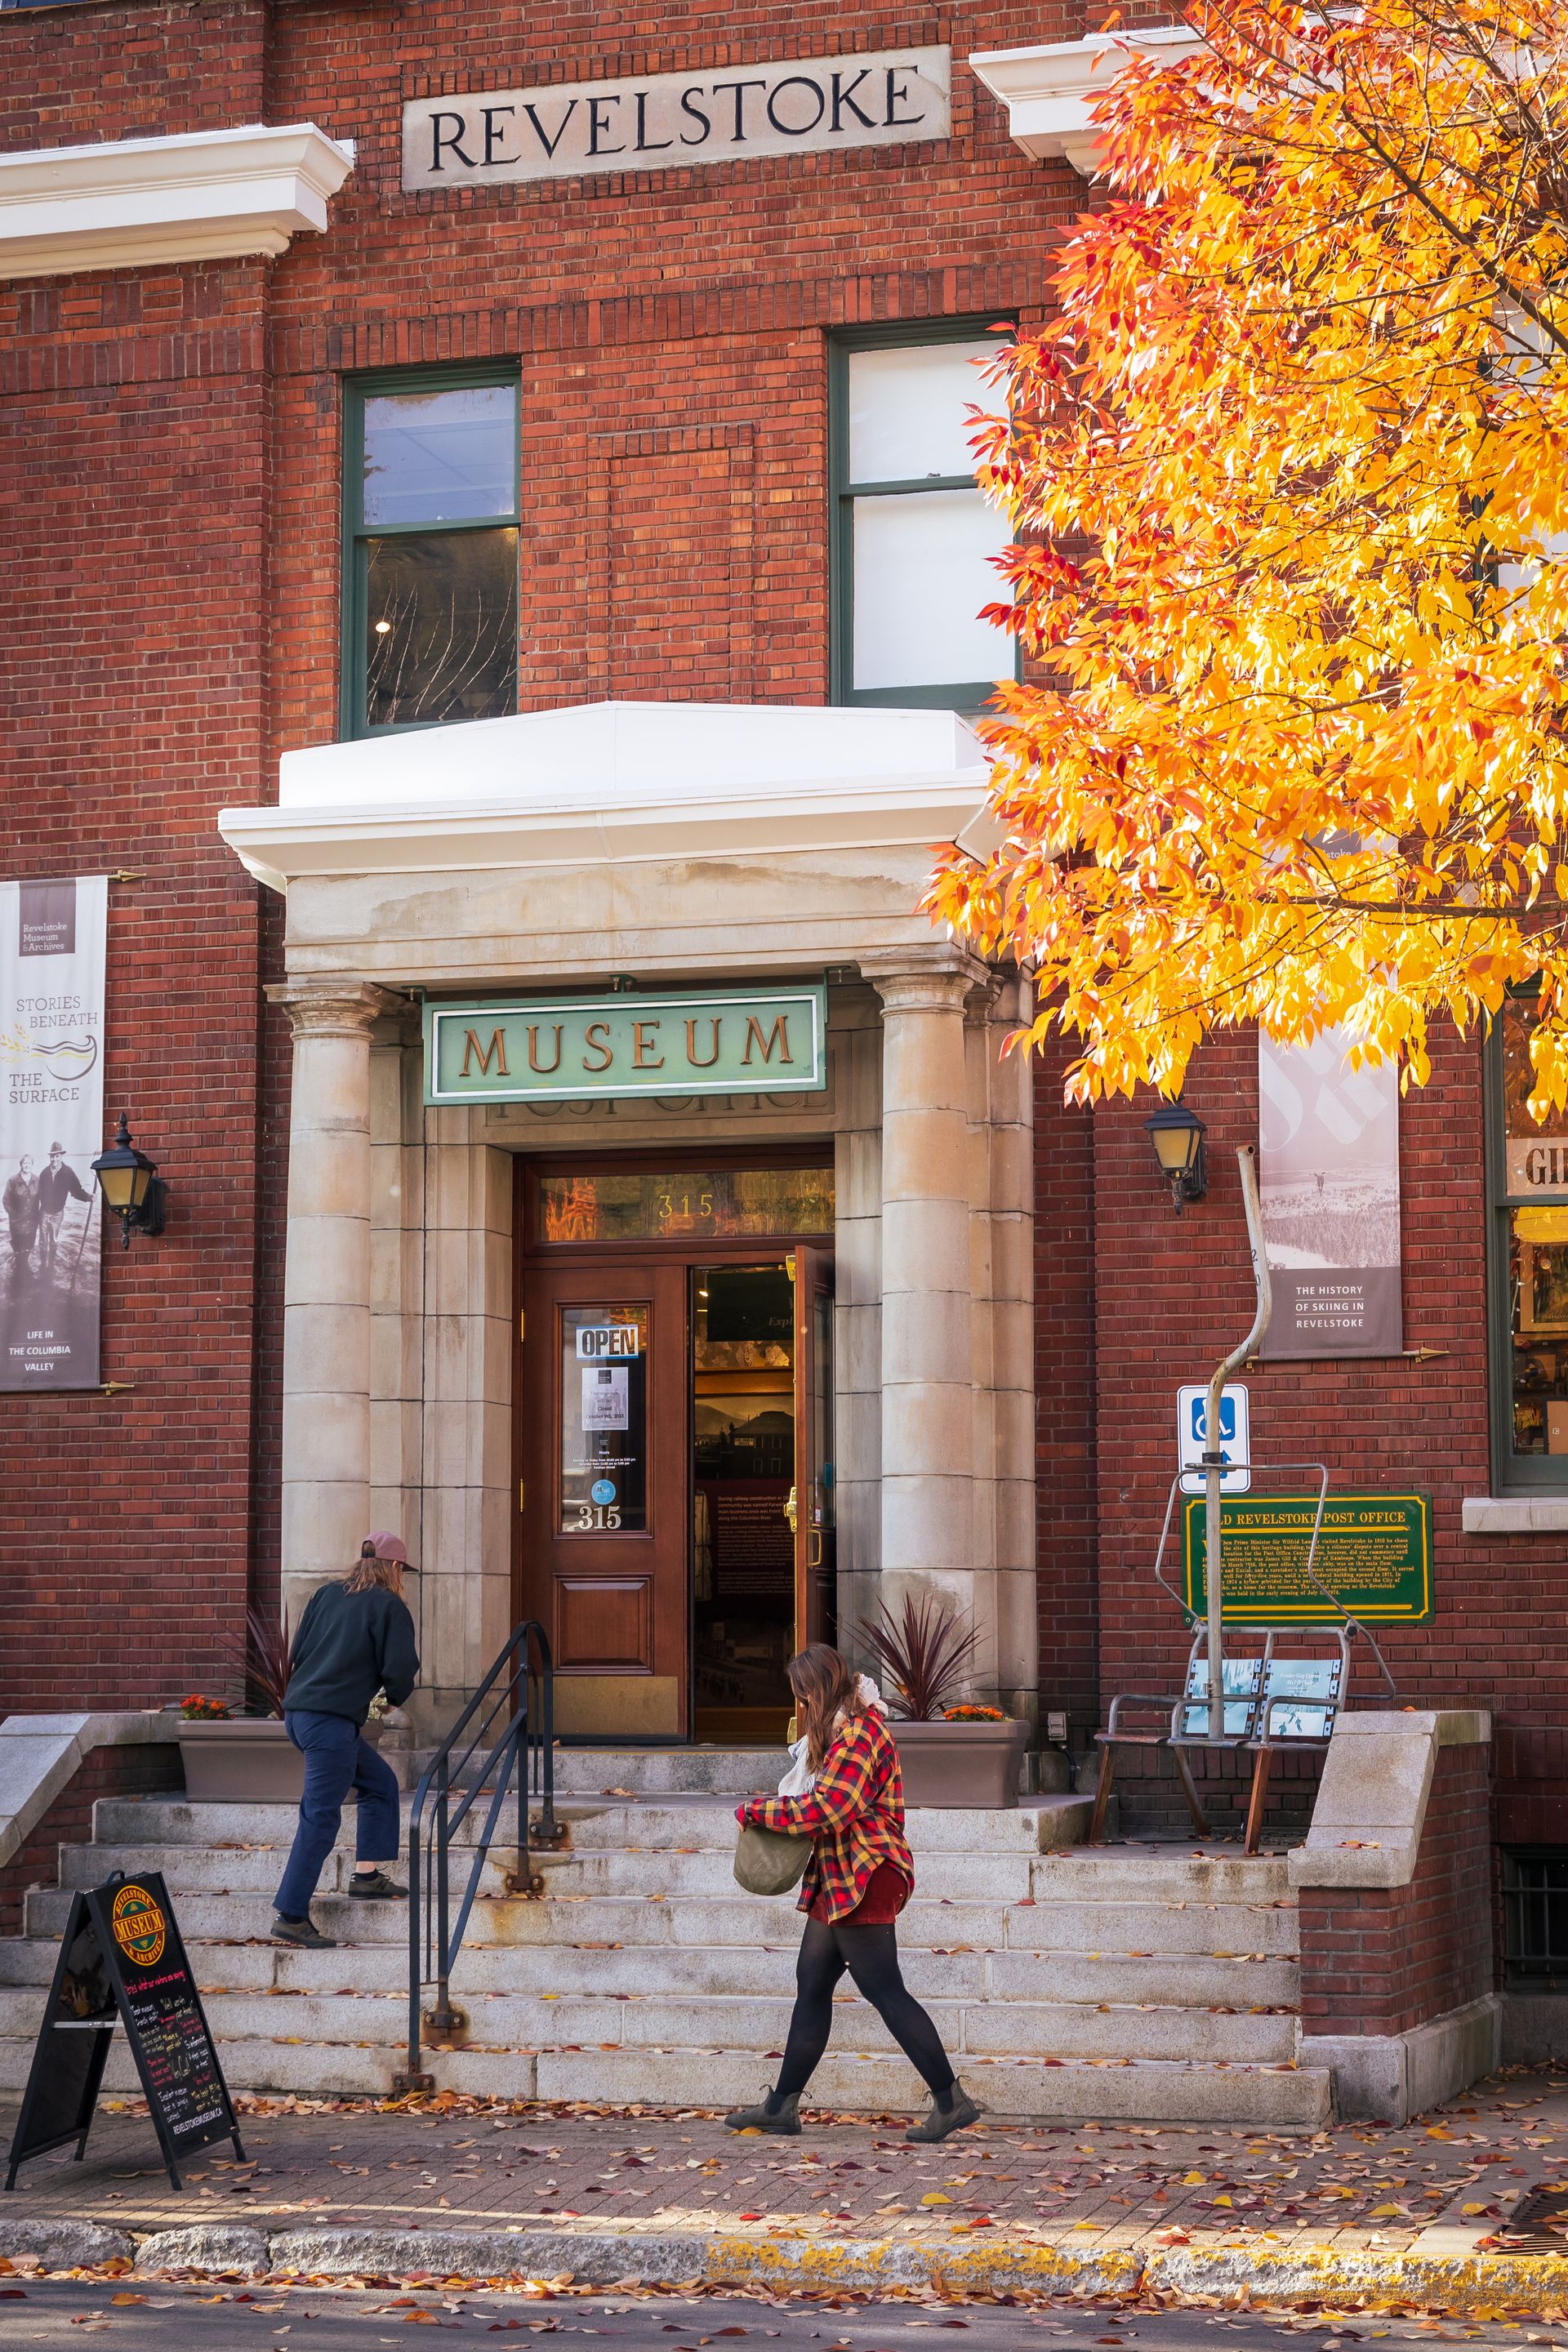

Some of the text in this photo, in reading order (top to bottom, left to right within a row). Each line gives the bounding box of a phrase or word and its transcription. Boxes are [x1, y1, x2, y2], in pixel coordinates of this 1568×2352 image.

[428, 65, 926, 172] REVELSTOKE
[23, 922, 67, 933] Revelstoke
[23, 933, 58, 942] Museum
[16, 996, 81, 1012] STORIES
[29, 1013, 98, 1028] BENEATH
[458, 1014, 793, 1076] MUSEUM
[9, 1073, 42, 1087] THE
[9, 1088, 79, 1104] SURFACE
[659, 1194, 713, 1218] 315
[1319, 1286, 1363, 1294] HISTORY
[1312, 1302, 1349, 1311] SKIING
[1353, 1302, 1364, 1310] IN
[1296, 1319, 1363, 1328] REVELSTOKE
[27, 1330, 53, 1339] LIFE IN
[9, 1345, 71, 1356] THE COLUMBIA
[582, 1330, 635, 1356] OPEN
[25, 1363, 54, 1371] VALLEY
[578, 1506, 621, 1529] 315
[1237, 1513, 1317, 1525] REVELSTOKE
[1323, 1512, 1354, 1523] POST
[1359, 1511, 1405, 1523] OFFICE
[116, 1889, 152, 1915] REVELSTOKE
[116, 1911, 163, 1940] MUSEUM
[137, 1938, 162, 1962] ARCHIVES
[172, 2107, 223, 2135] REVELSTOKEMUSEUM.CA
